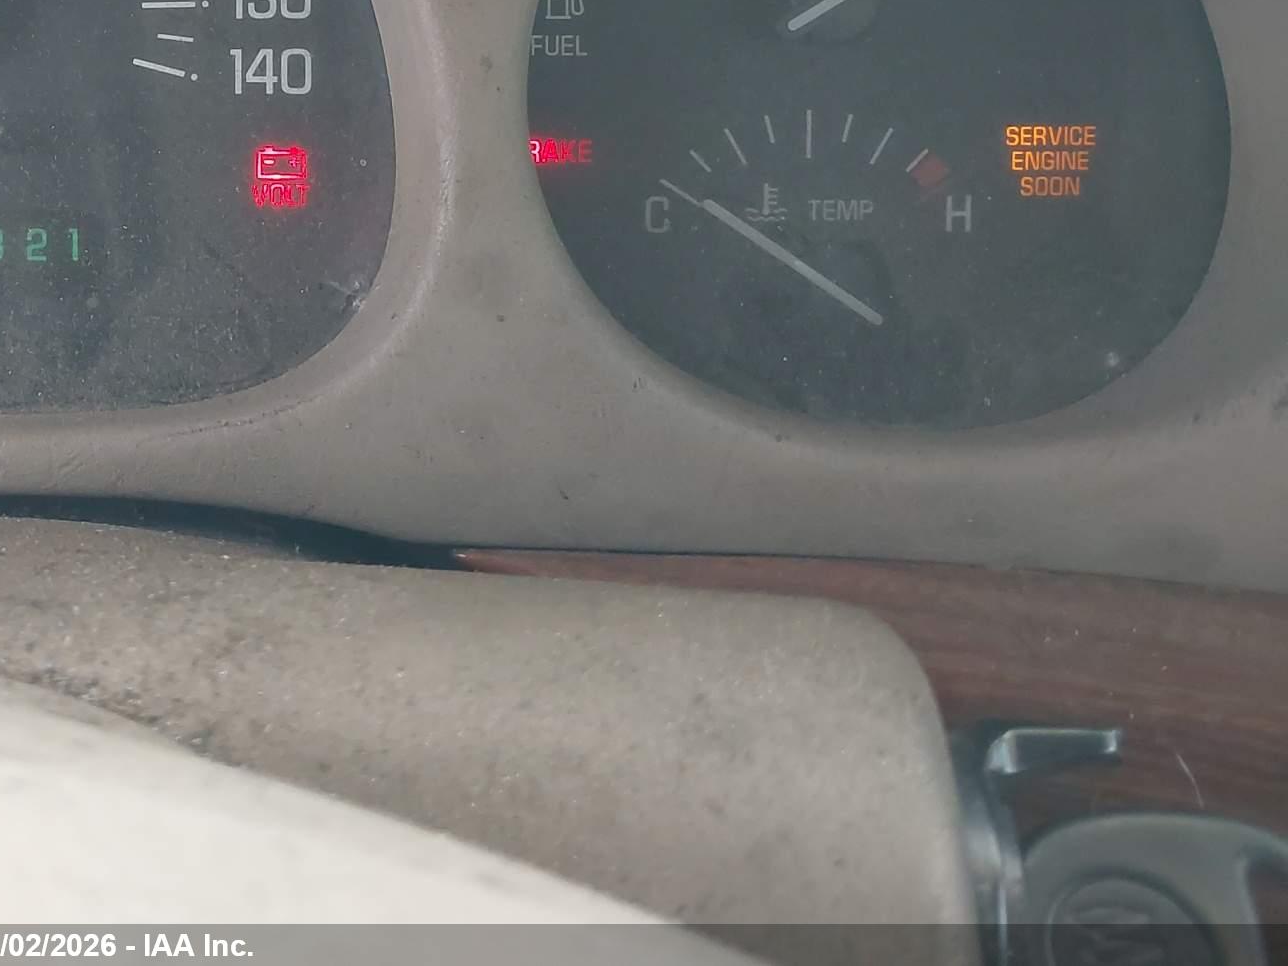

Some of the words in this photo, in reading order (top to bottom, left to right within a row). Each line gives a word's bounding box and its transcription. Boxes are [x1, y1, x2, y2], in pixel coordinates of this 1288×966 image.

[530, 34, 588, 57] FUEL
[230, 48, 312, 95] 140
[1006, 125, 1097, 147] SERVICE
[528, 138, 593, 163] RAKE
[1011, 151, 1089, 172] ENGINE
[251, 183, 310, 208] VOLT
[1020, 175, 1081, 197] SOON
[644, 195, 672, 234] C
[808, 199, 873, 222] TEMP
[945, 194, 973, 232] H
[26, 228, 48, 262] 2
